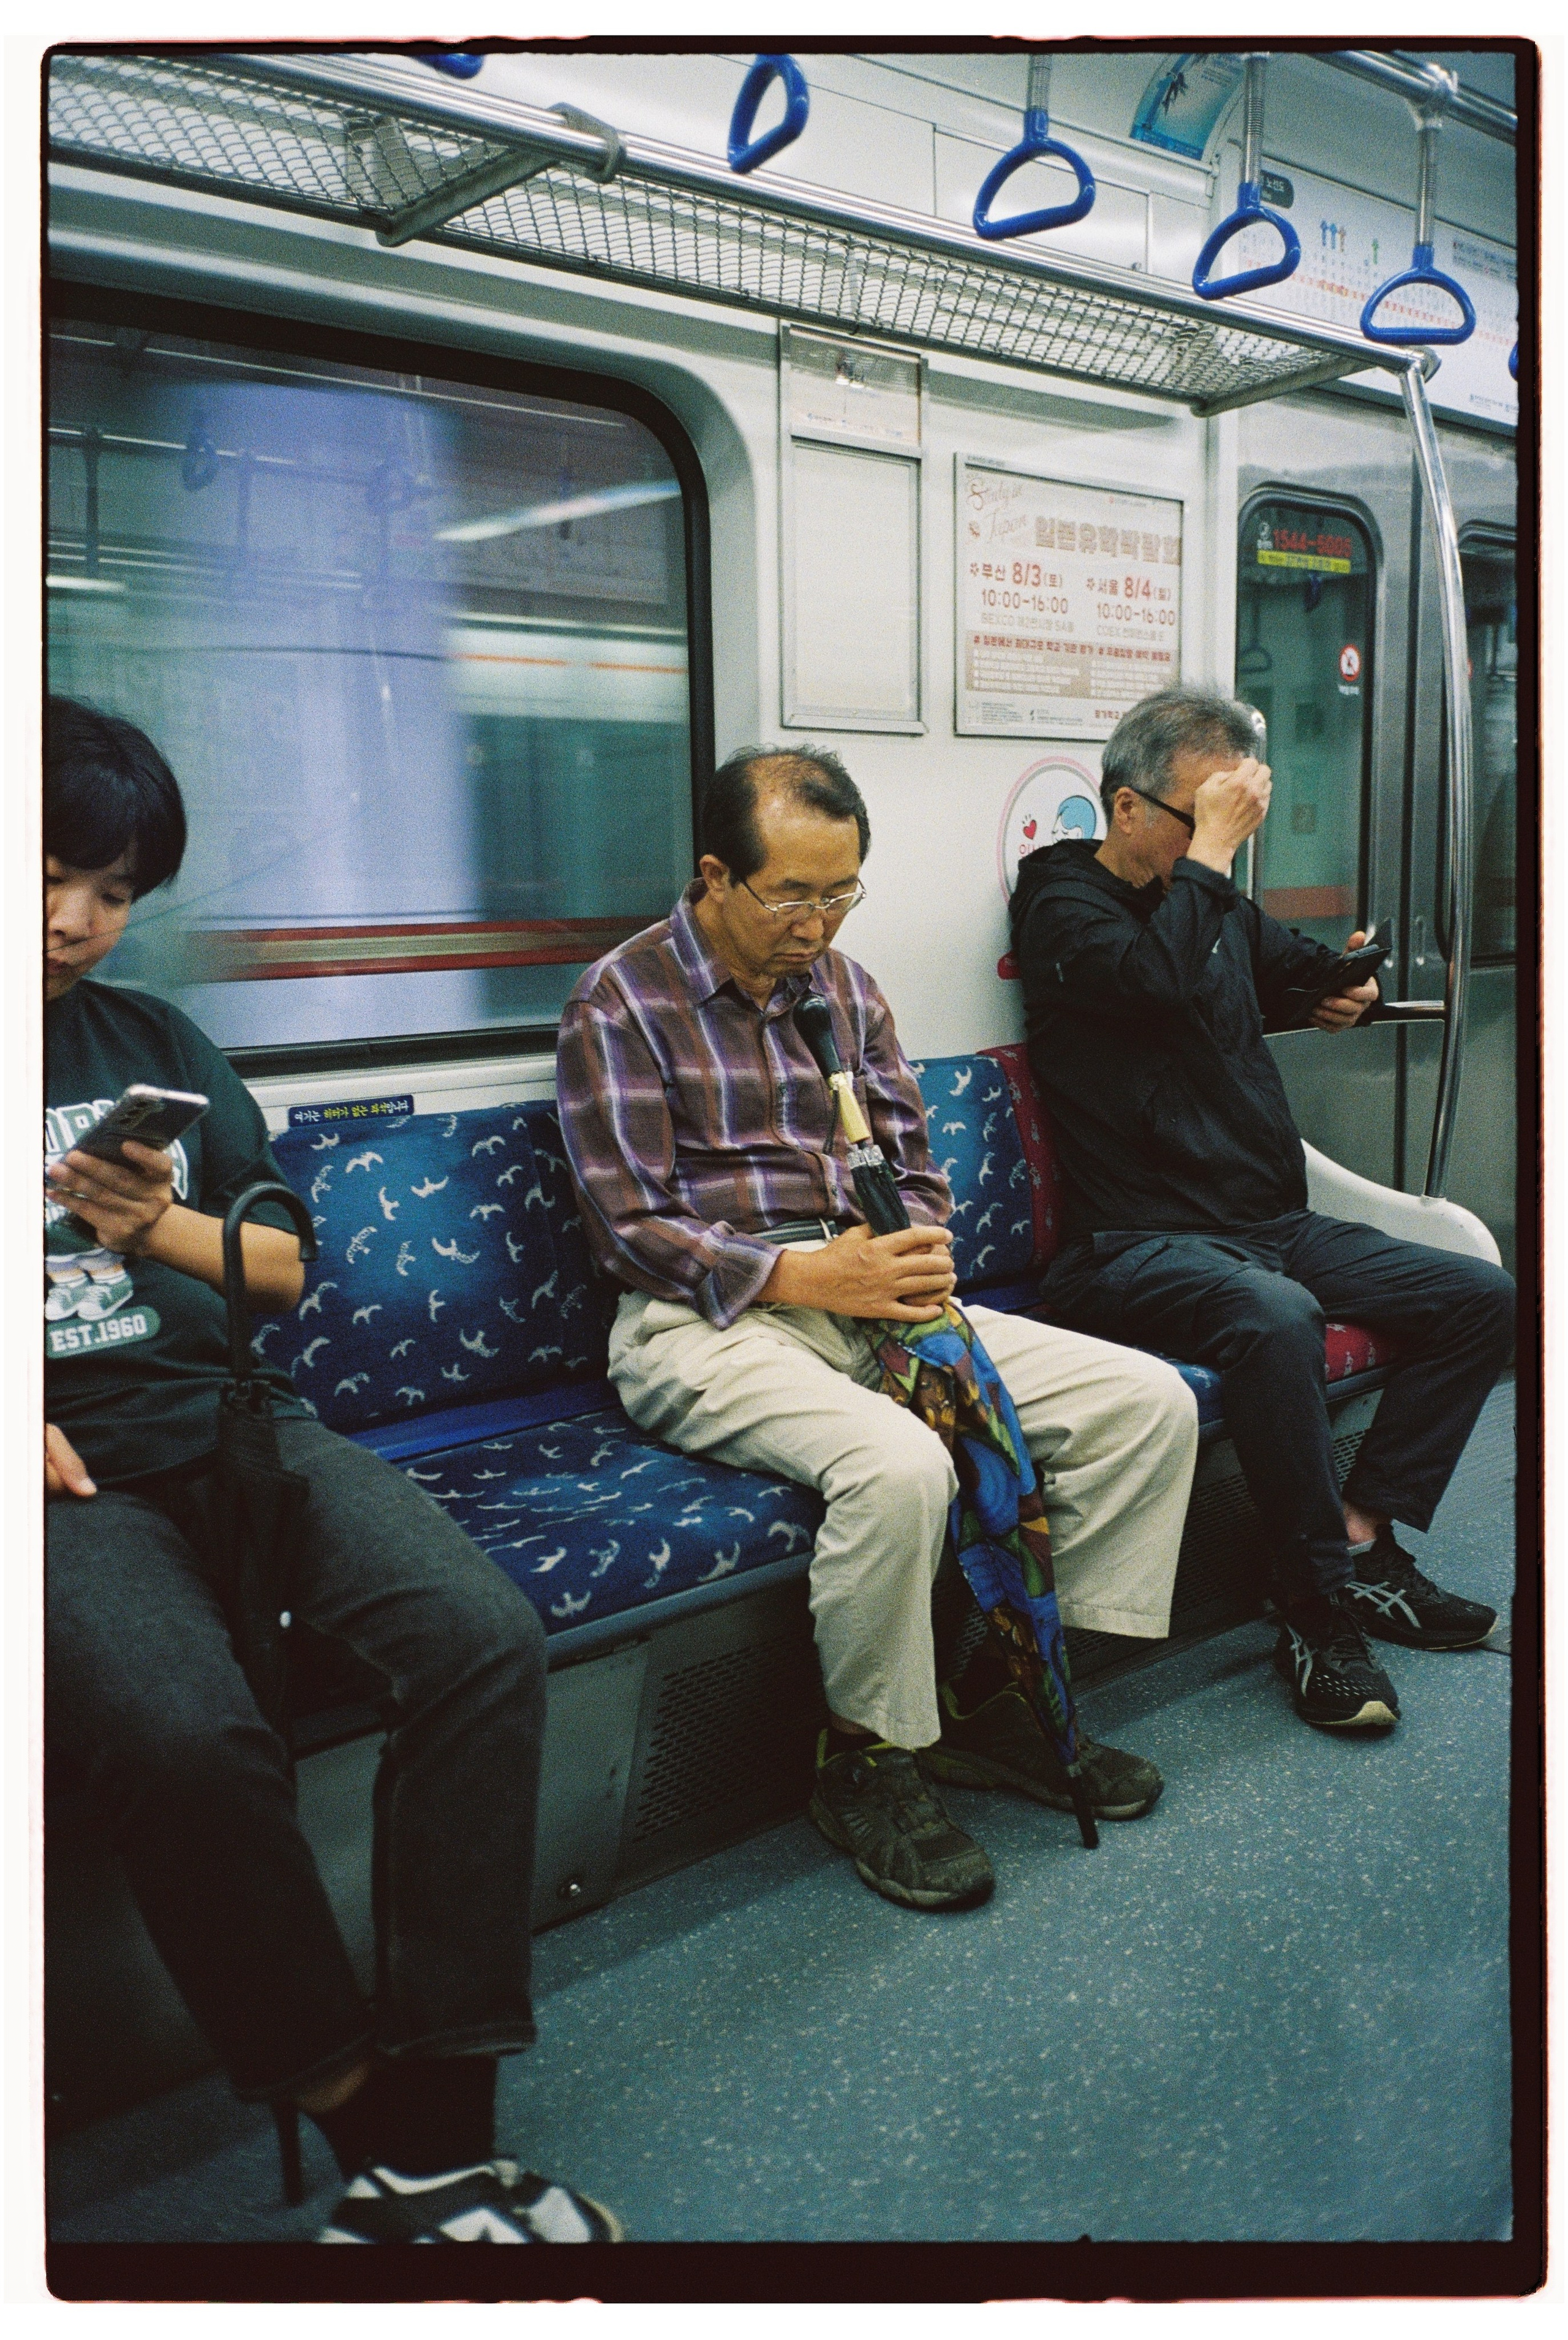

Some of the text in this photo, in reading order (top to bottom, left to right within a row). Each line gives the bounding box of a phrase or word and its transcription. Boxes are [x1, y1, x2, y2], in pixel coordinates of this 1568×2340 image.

[981, 562, 1006, 582] 부산
[1097, 578, 1118, 596] 서울
[981, 588, 1068, 614] 10:00-16:00
[1096, 602, 1176, 626] 10:00-16:00
[50, 1313, 148, 1352] EST.1960
